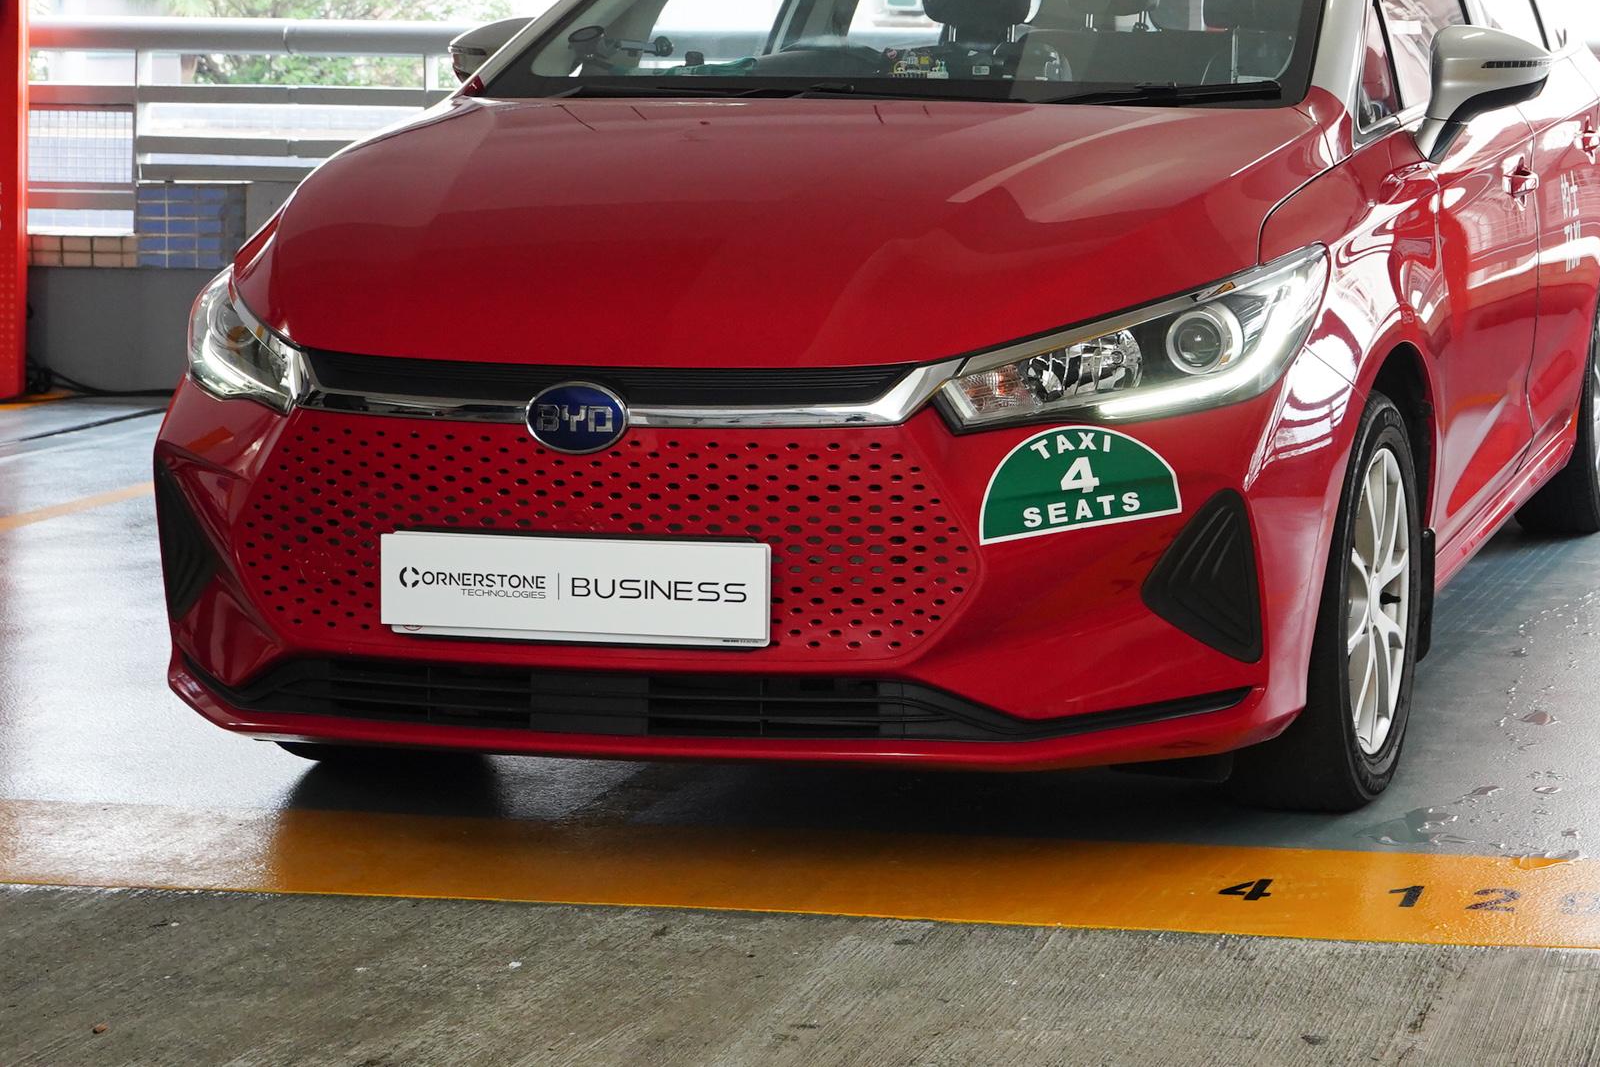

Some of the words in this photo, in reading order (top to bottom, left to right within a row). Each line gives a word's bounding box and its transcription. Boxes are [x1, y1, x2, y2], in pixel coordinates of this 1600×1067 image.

[536, 404, 613, 433] BYD
[1029, 432, 1112, 460] TAXI
[1060, 456, 1100, 493] 4
[1023, 492, 1141, 528] SEATS
[399, 566, 546, 590] CORNERSTONE
[571, 576, 747, 603] BUSINESS
[461, 588, 546, 600] TECHNOLOGIES
[1218, 878, 1274, 901] 4
